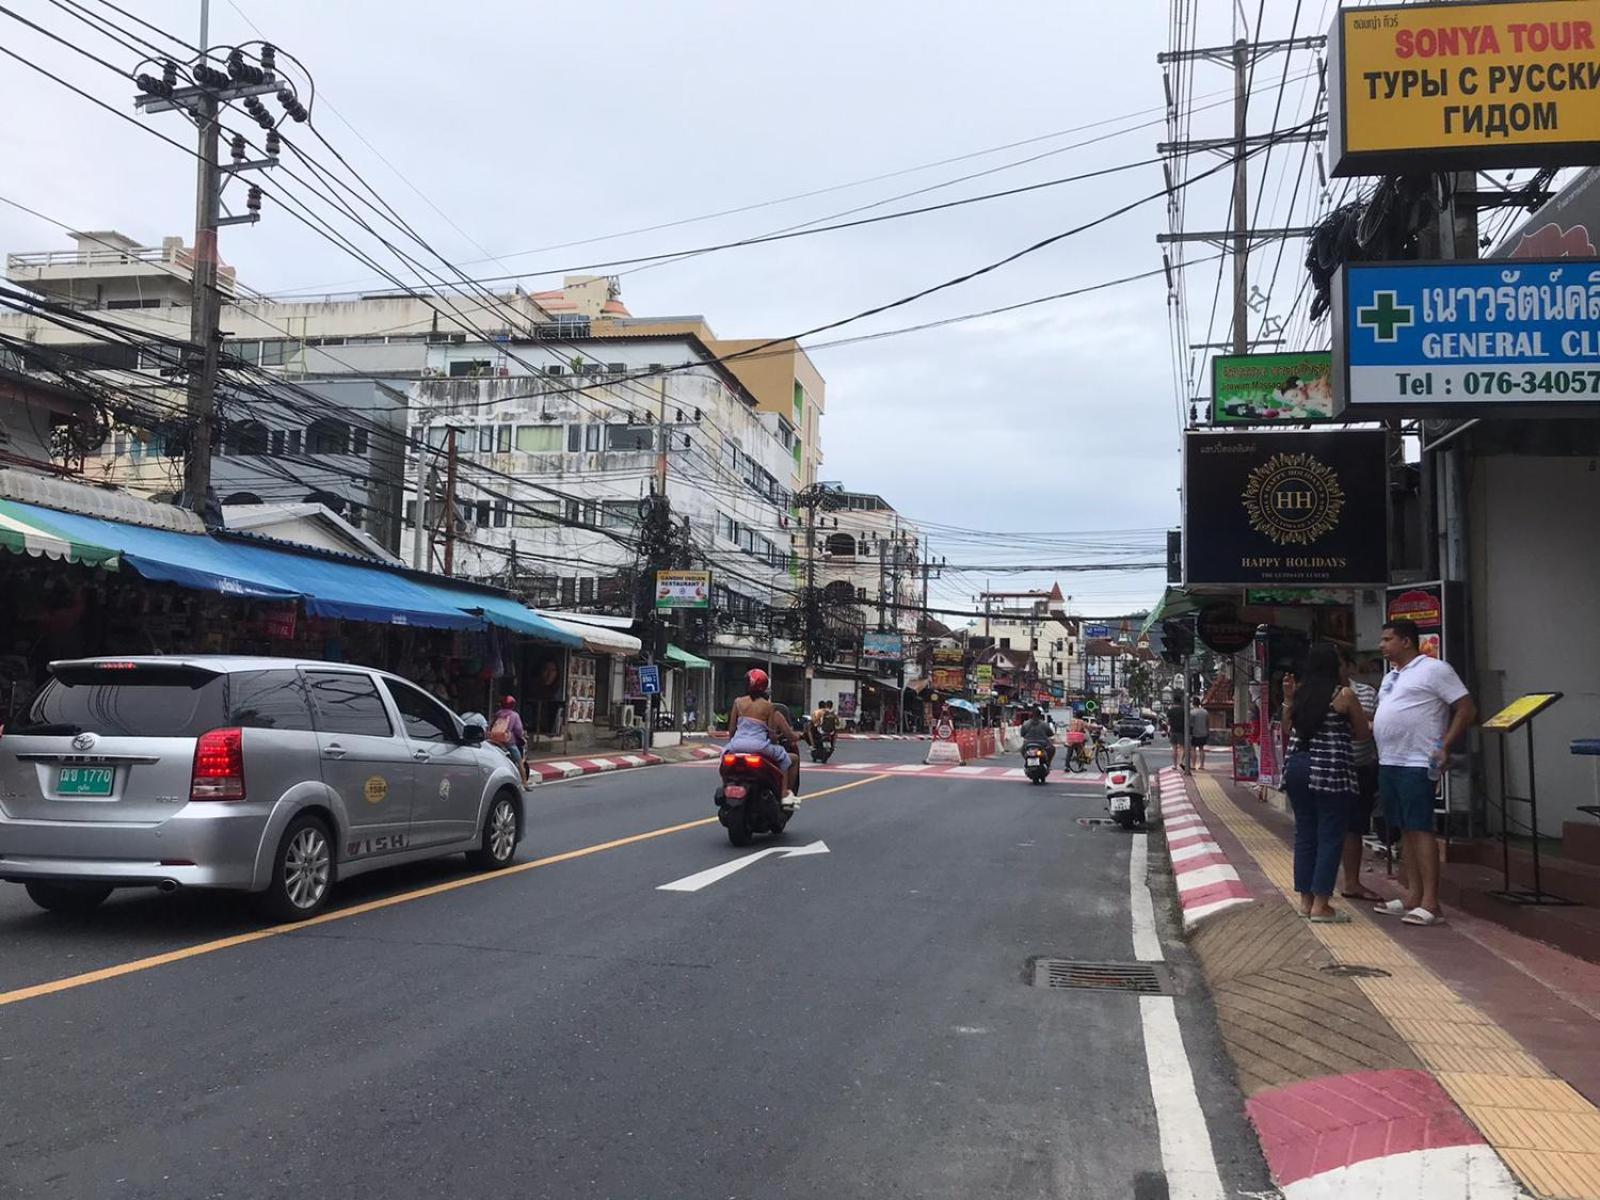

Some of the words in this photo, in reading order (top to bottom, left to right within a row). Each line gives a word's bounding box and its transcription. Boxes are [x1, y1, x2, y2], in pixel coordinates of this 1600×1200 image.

[1396, 26, 1501, 58] SONYA
[1508, 21, 1596, 52] TOUR
[1363, 68, 1448, 99] ТУРЫ
[1458, 67, 1478, 95] С
[1443, 102, 1558, 138] ГИДОМ
[1422, 331, 1549, 358] GENERAL
[1395, 372, 1433, 395] Tel
[1463, 370, 1600, 395] 076-34057
[1277, 491, 1312, 509] HH
[1241, 557, 1281, 568] HAPPY
[1285, 557, 1347, 569] HOLIDAYS
[84, 769, 111, 783] 1770
